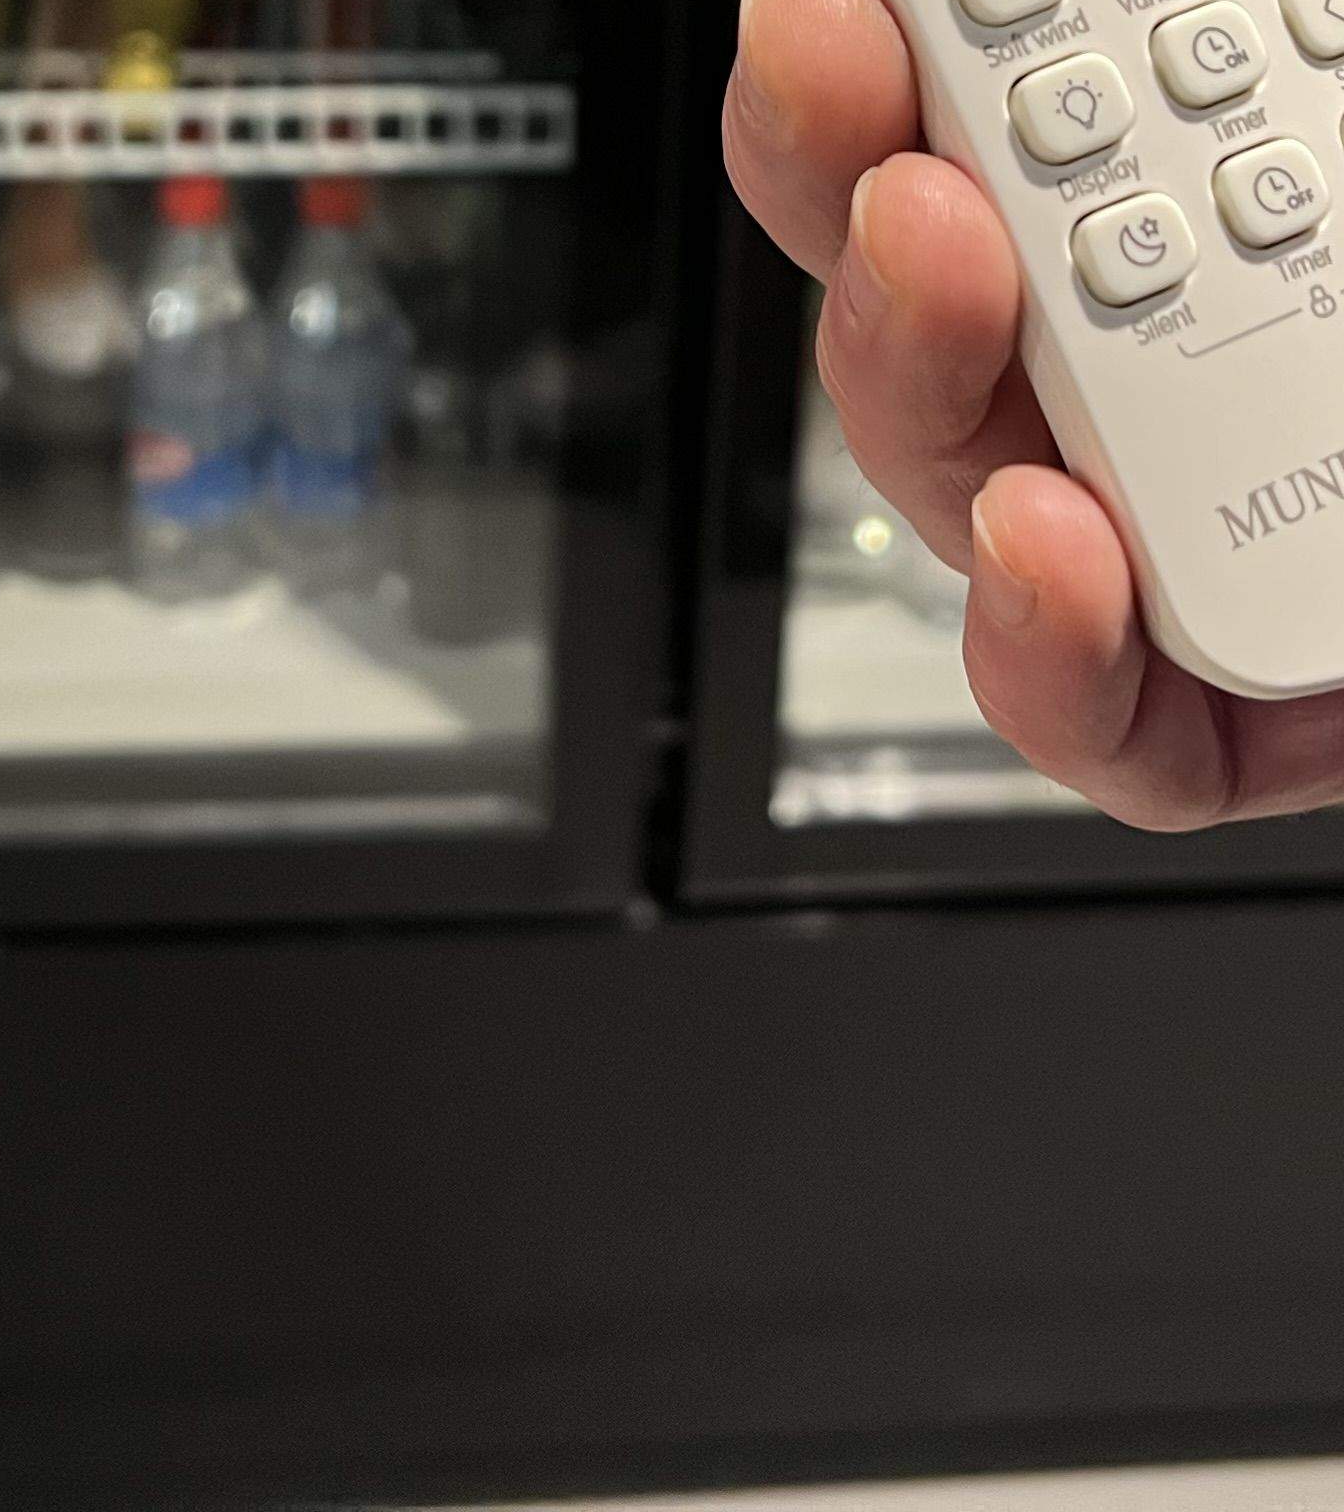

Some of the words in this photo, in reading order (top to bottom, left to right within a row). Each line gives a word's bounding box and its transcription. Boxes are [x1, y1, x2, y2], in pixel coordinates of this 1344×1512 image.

[981, 33, 1028, 68] Soft
[1030, 8, 1091, 50] wind
[1224, 47, 1250, 69] ON
[1208, 104, 1269, 145] Timer
[1056, 157, 1142, 205] Display
[1286, 187, 1316, 212] OFF
[1272, 243, 1333, 285] Timer
[1131, 300, 1197, 346] Silent
